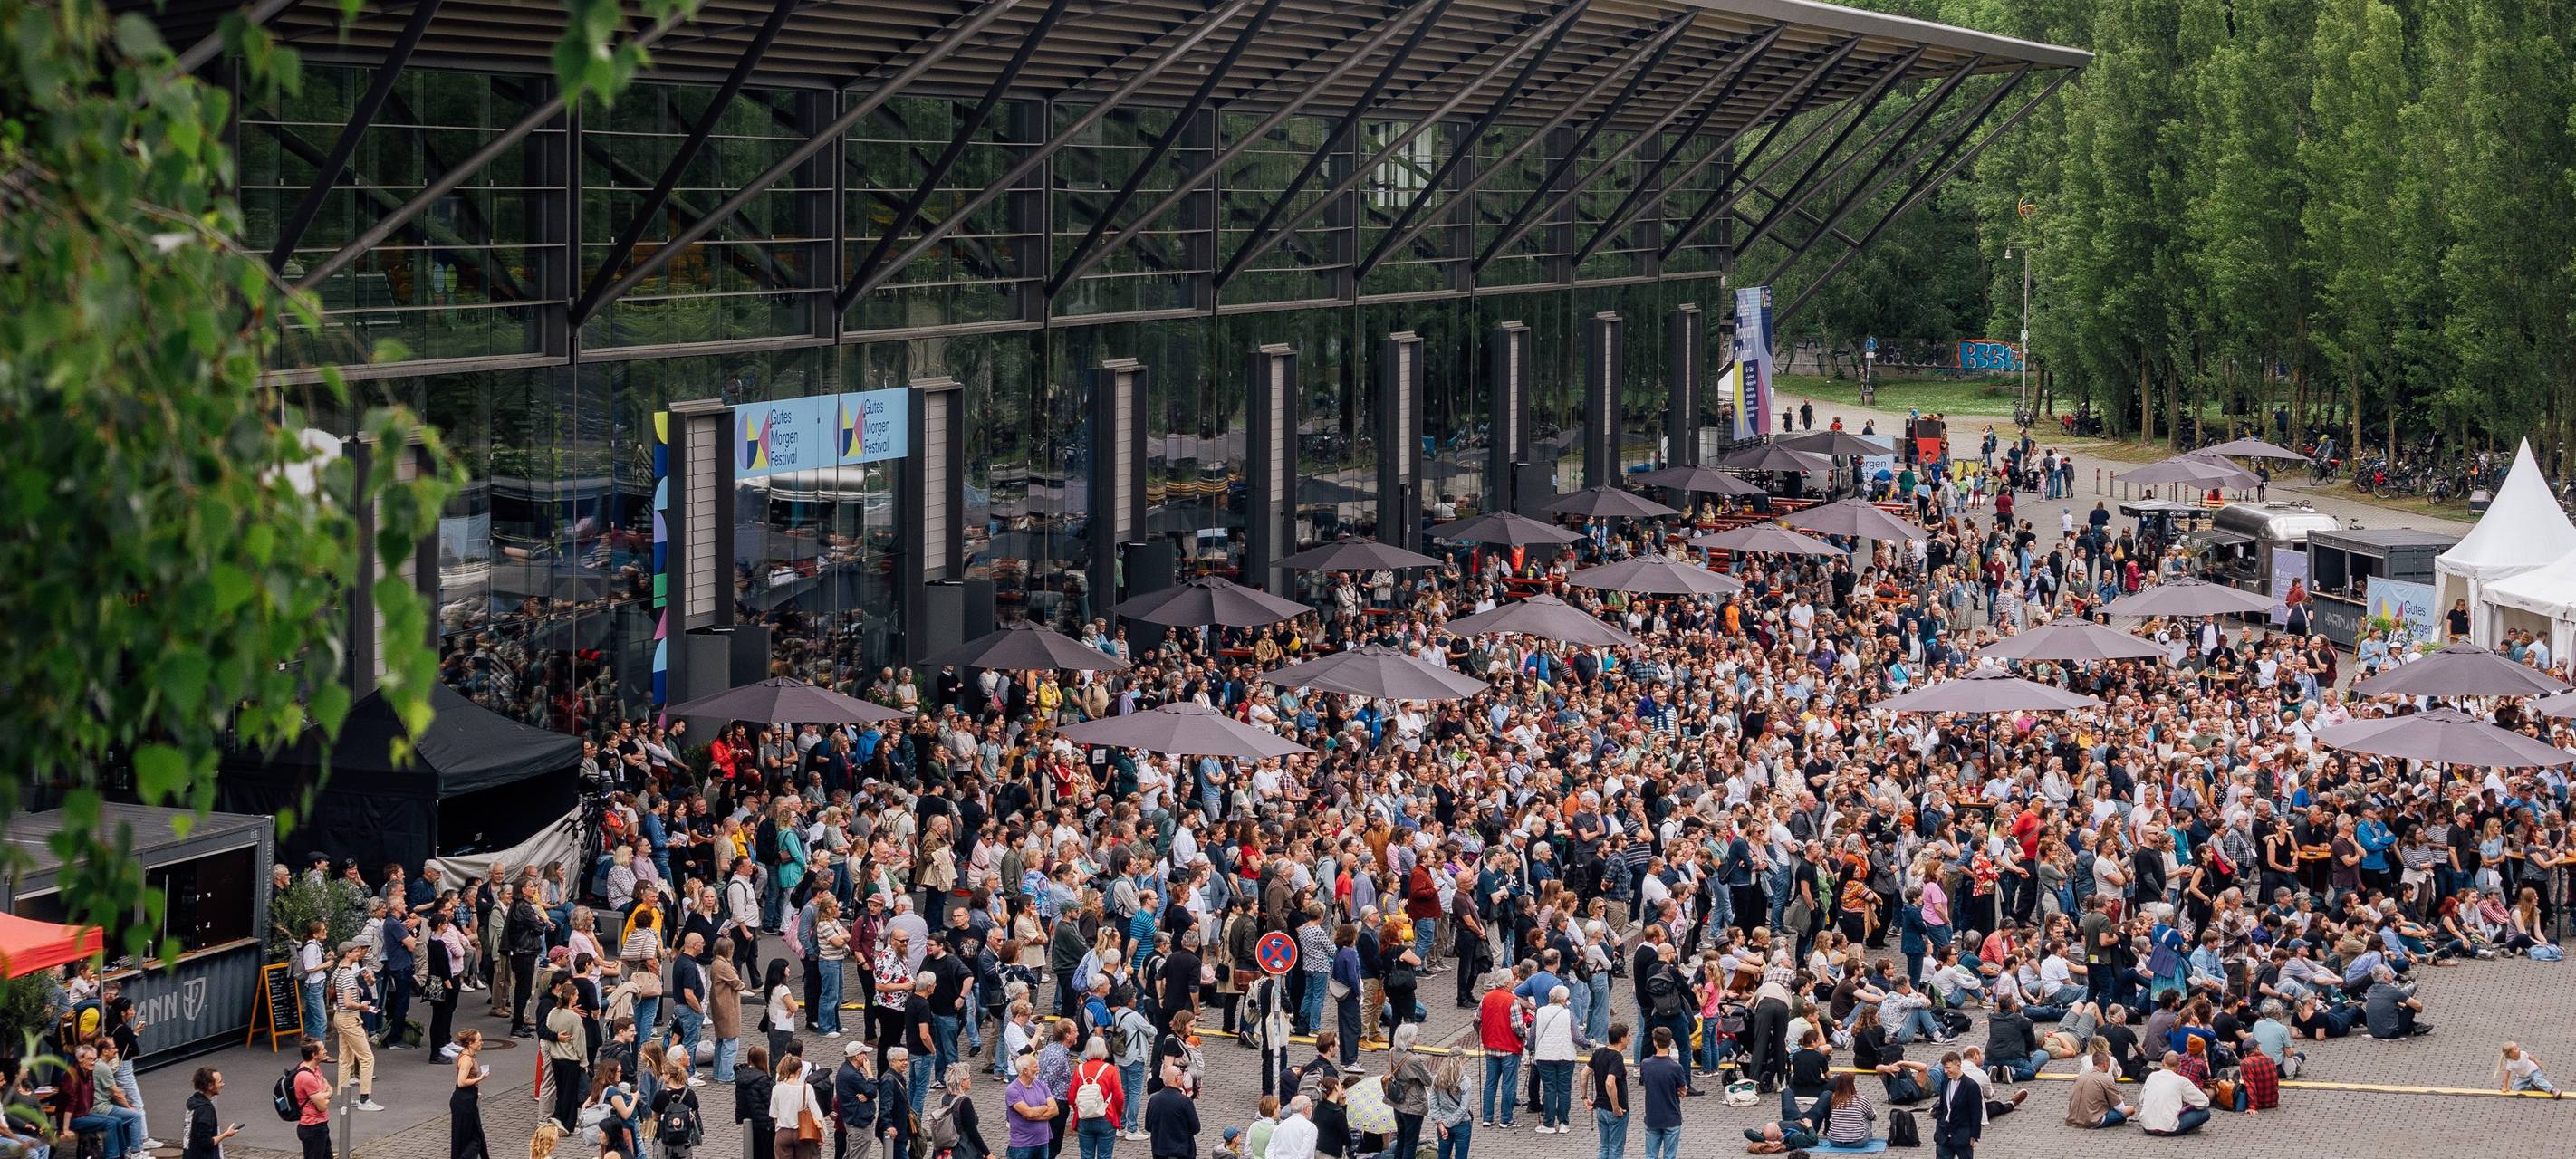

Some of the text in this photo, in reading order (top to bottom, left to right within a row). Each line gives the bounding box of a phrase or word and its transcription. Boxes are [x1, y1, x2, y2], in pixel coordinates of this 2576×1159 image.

[864, 399, 884, 415] Gutes
[771, 408, 792, 426] Gutes
[864, 419, 890, 437] Morgen
[771, 430, 798, 449] Morgen
[864, 436, 889, 454] Festival
[771, 448, 798, 467] Festival
[1861, 460, 1887, 470] orgen
[2405, 600, 2426, 617] Gutes
[133, 991, 178, 1028] ANN
